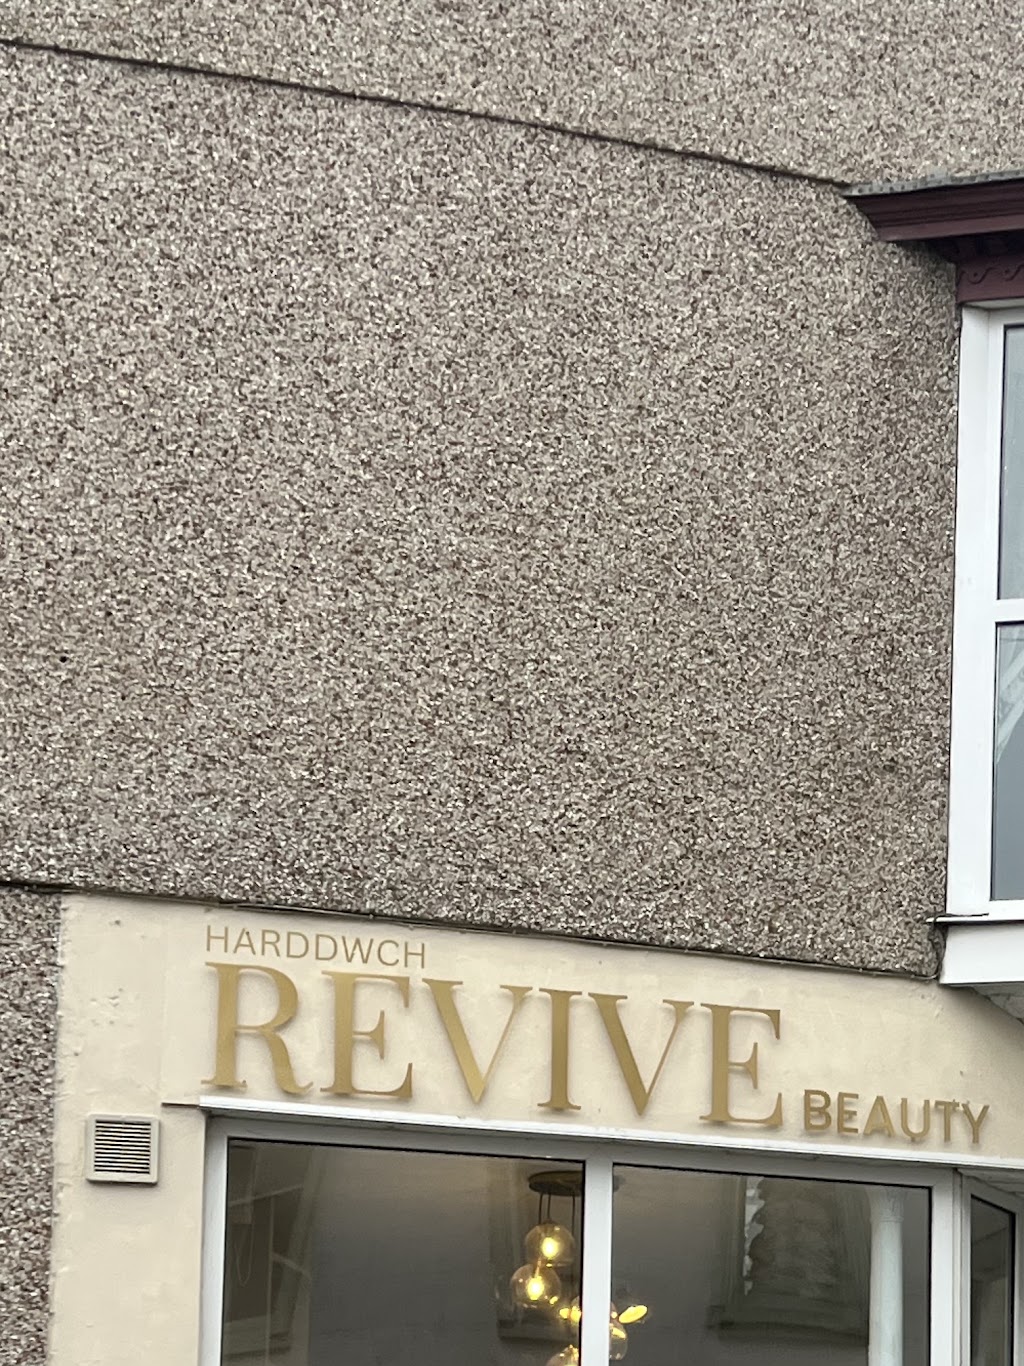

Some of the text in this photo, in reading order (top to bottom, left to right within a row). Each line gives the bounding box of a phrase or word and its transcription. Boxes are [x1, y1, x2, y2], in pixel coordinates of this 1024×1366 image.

[206, 924, 426, 969] HARDDWCH
[201, 961, 990, 1143] REVIVE BEAUTY
